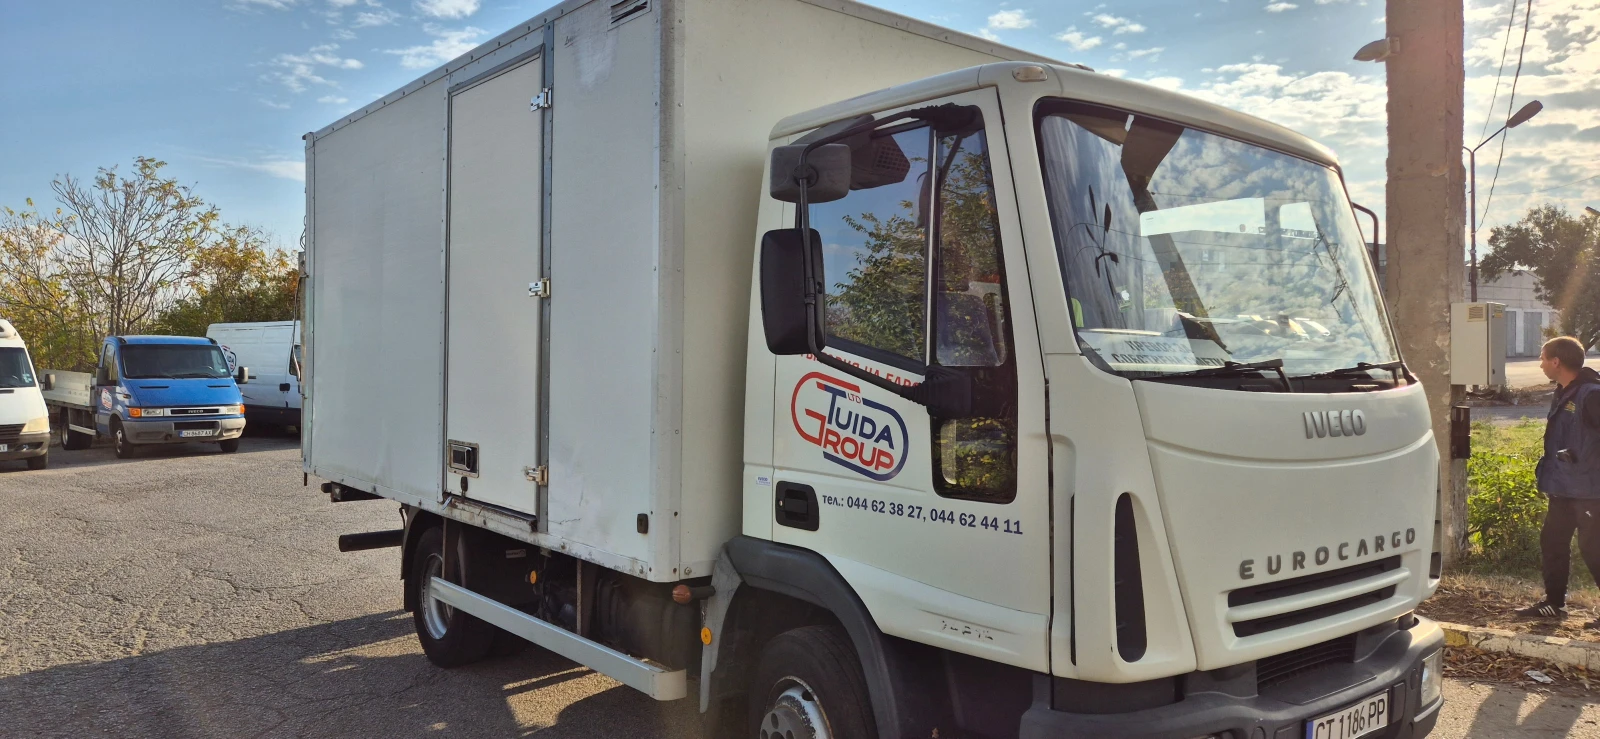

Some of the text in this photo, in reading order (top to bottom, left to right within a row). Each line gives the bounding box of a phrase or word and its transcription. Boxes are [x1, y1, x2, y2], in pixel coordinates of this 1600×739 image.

[816, 381, 895, 450] TUIDA
[848, 392, 862, 404] LTD
[791, 390, 895, 471] GROUP
[1303, 409, 1367, 439] IVECO
[822, 494, 1024, 535] тел.: 044 62 38 27, 044 62 44 11
[1239, 528, 1416, 580] EUROCARGO
[1315, 698, 1386, 739] CT 1186 PP
